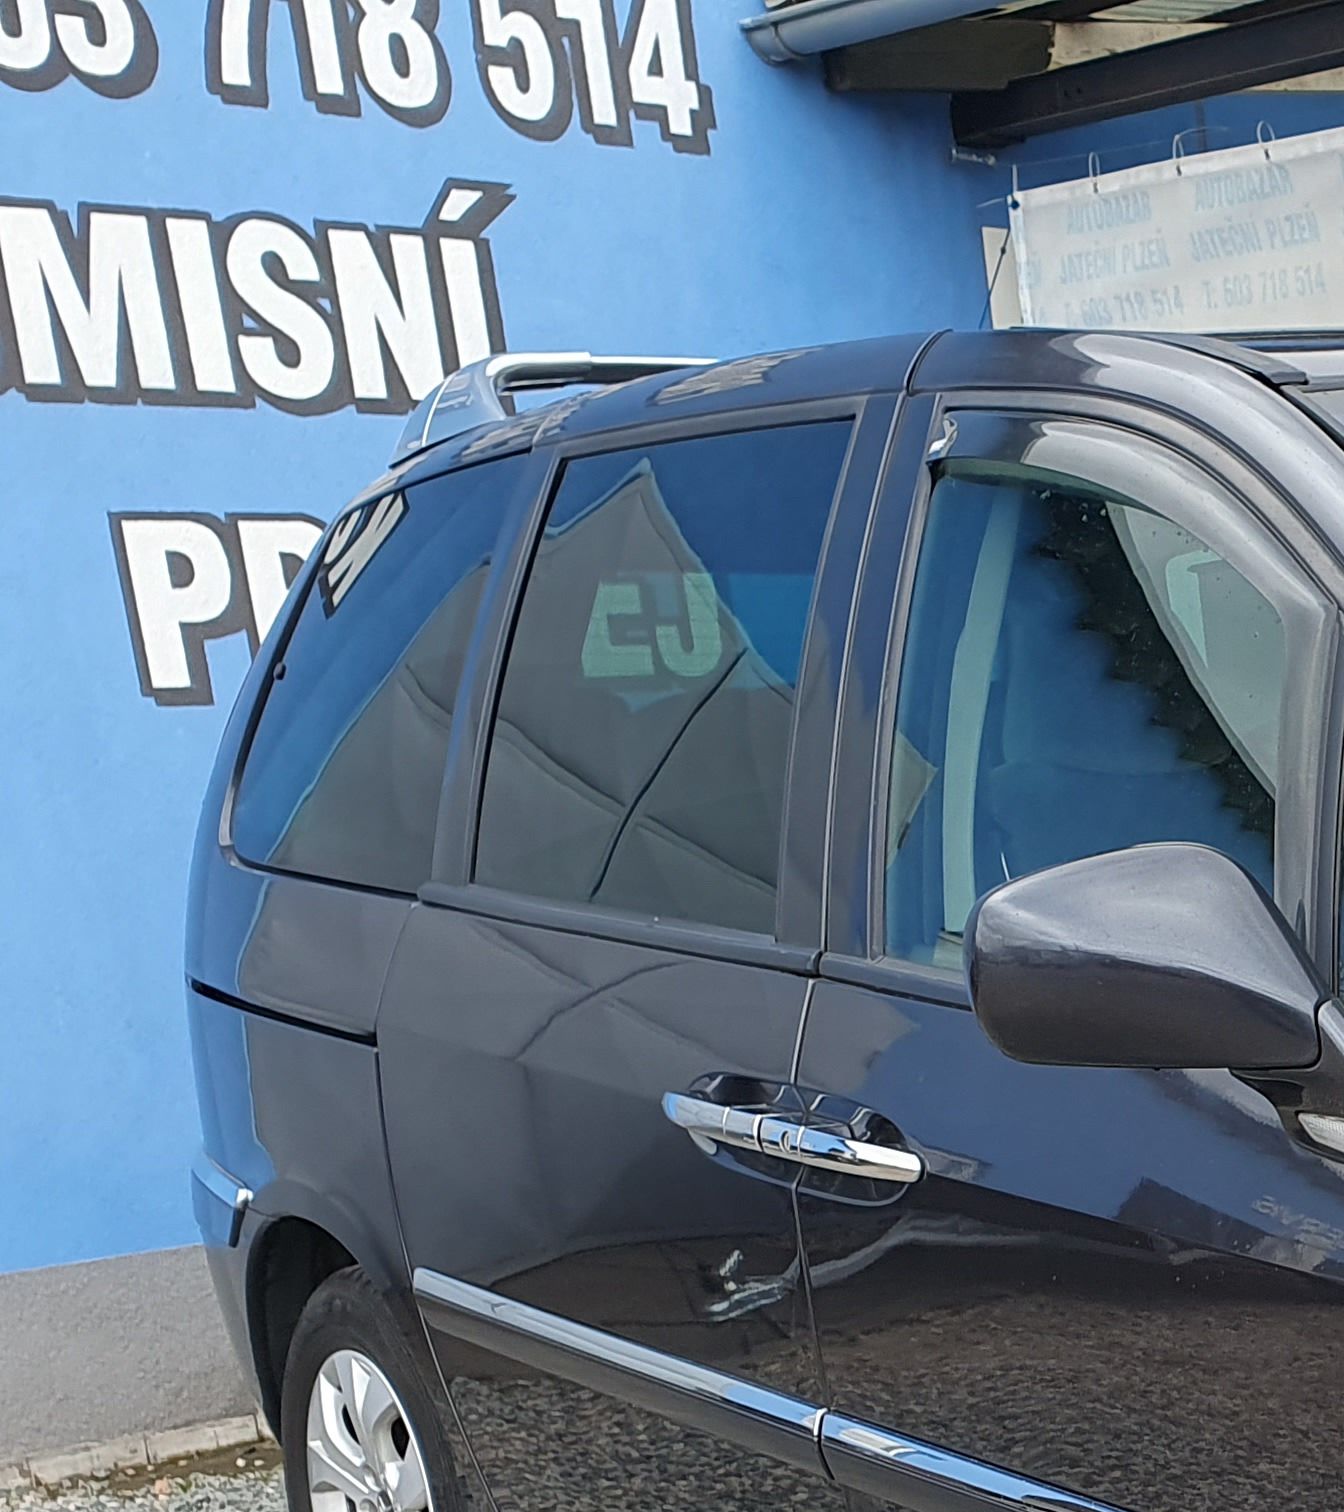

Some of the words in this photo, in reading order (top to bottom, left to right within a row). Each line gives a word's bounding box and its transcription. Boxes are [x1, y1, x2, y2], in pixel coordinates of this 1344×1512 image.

[475, 0, 708, 146] 514
[1194, 163, 1294, 211] AUTOBAZAR
[1266, 205, 1320, 252] PLZEŇ
[1223, 274, 1254, 309] 603
[1260, 268, 1288, 302] 718
[1295, 262, 1326, 297] 514
